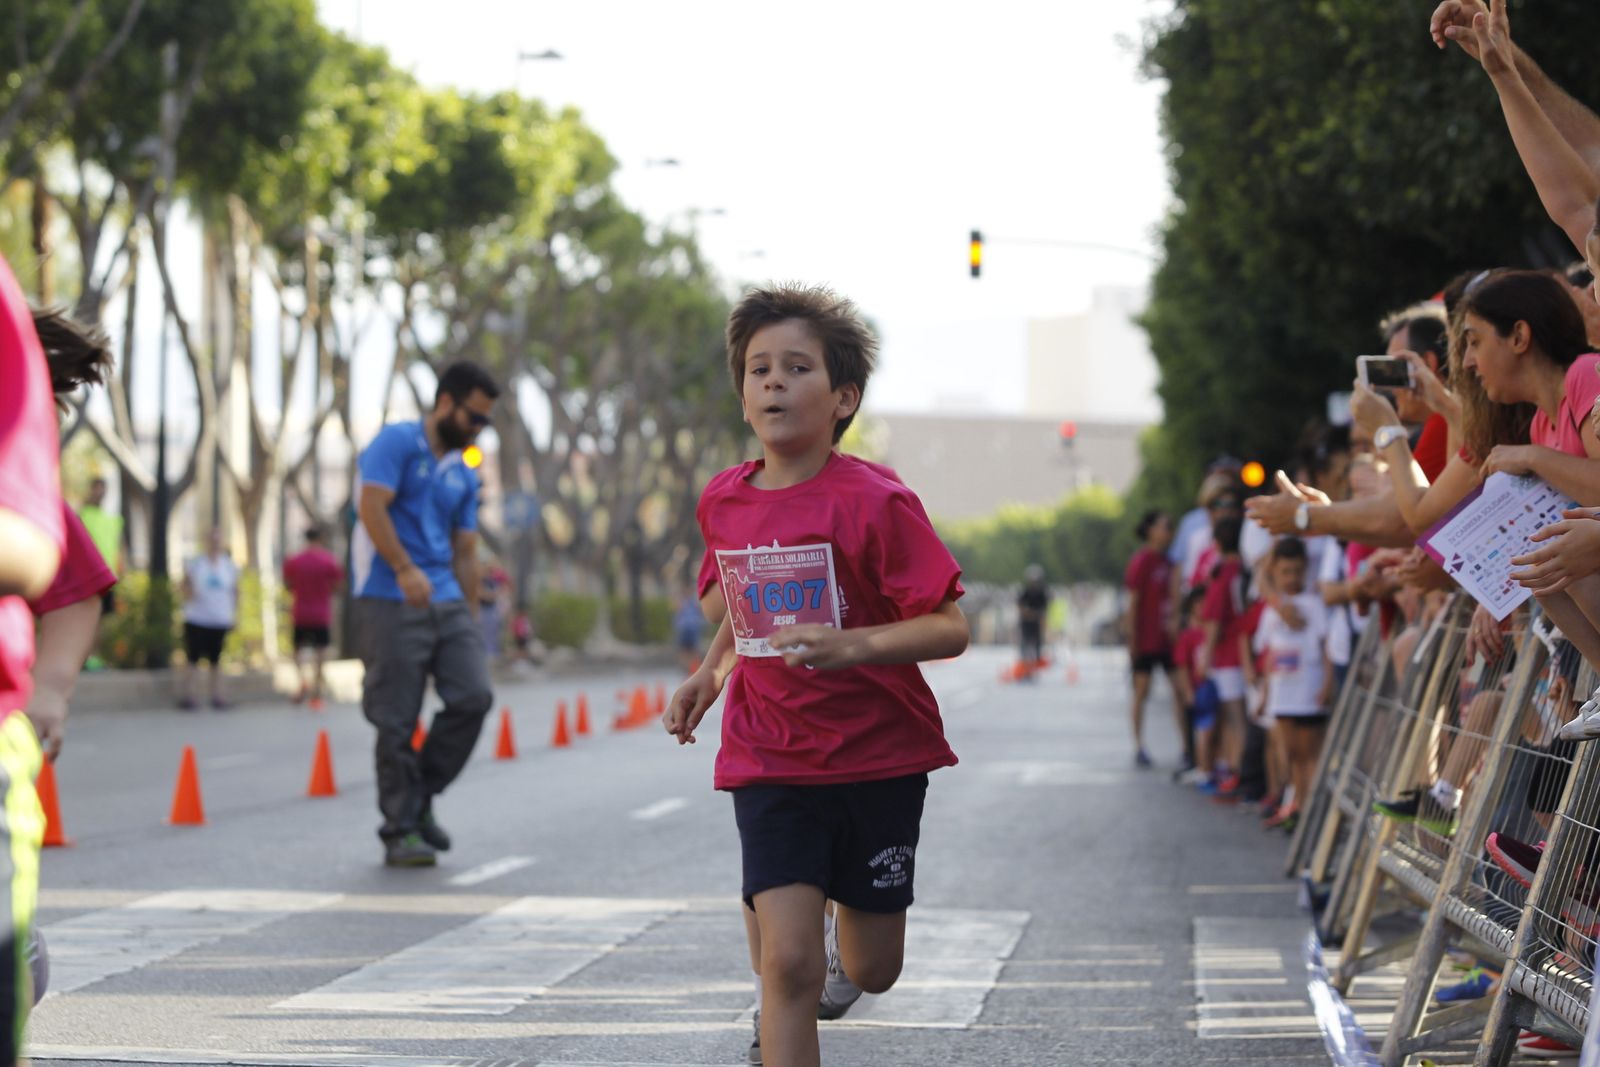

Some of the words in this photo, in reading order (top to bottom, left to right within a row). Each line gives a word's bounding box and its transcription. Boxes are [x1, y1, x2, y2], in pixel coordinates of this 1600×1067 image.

[785, 551, 825, 563] SOLIDARIA
[744, 577, 827, 614] 1607
[773, 615, 797, 626] JESUS
[868, 846, 897, 868] HIGHEST
